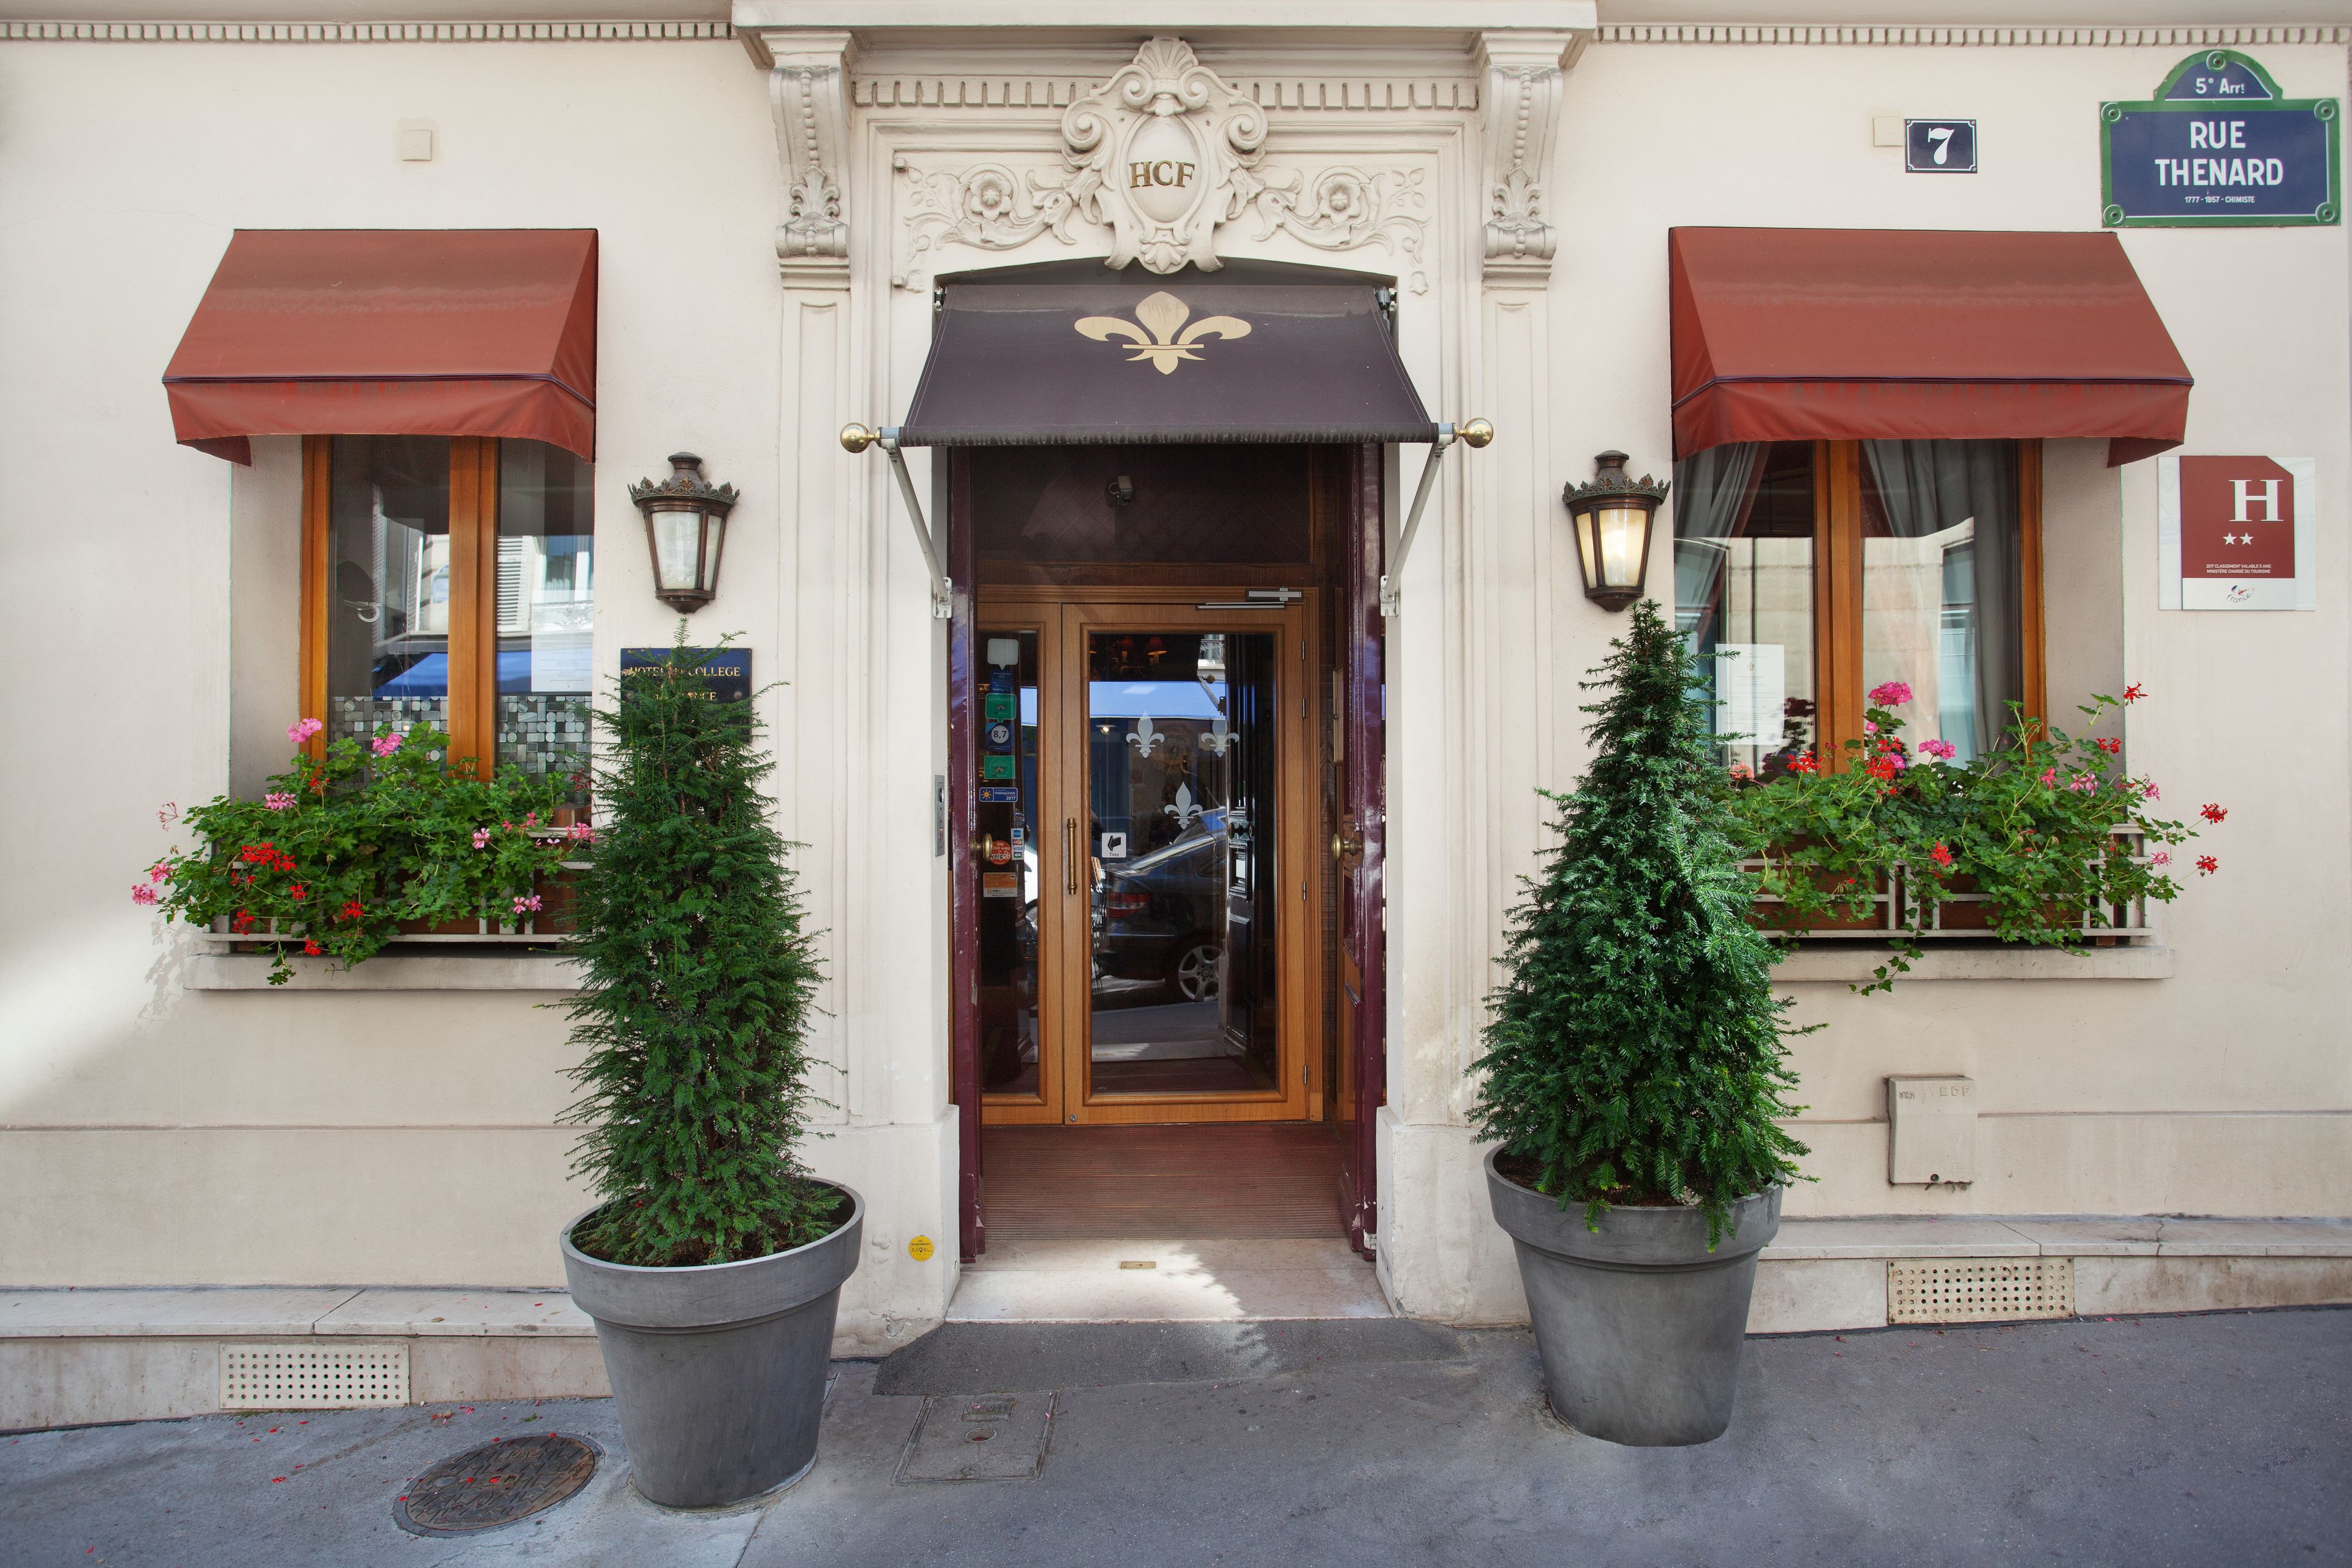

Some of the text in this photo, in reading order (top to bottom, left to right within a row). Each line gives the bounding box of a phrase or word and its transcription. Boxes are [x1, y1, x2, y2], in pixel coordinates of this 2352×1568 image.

[1928, 127, 1954, 165] 7
[2190, 121, 2246, 149] RUE
[1129, 160, 1195, 189] HCF
[2154, 158, 2283, 186] THENARD
[2228, 479, 2284, 522] H
[993, 730, 1007, 739] 8,7
[1940, 1087, 1970, 1096] EDF
